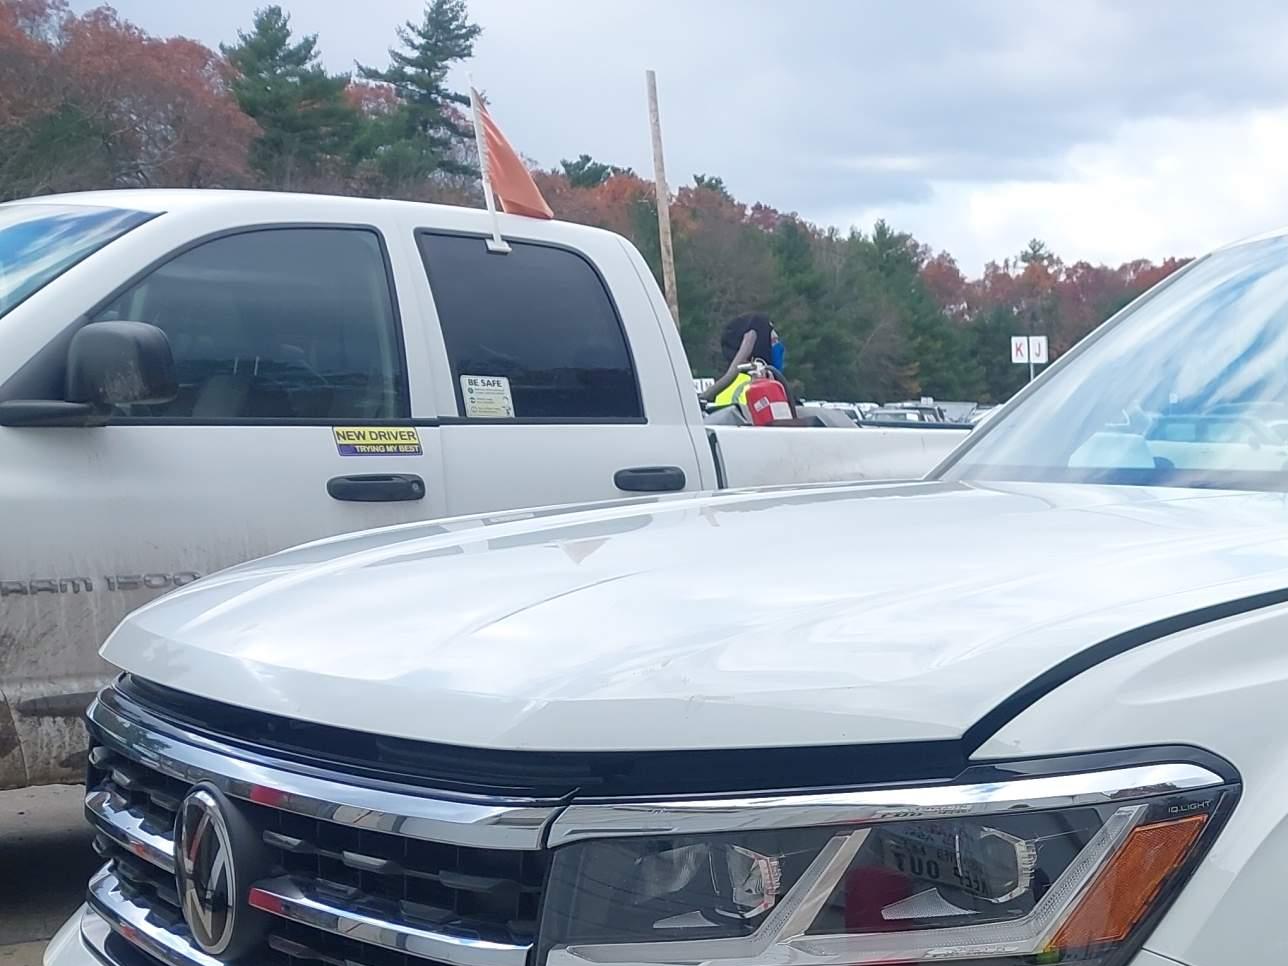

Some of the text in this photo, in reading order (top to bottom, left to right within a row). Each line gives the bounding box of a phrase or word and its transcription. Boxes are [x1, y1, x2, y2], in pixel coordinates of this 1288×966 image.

[1015, 342, 1024, 357] K
[1035, 342, 1041, 357] J
[467, 378, 503, 388] BE SAFE
[335, 430, 417, 441] NEW DRIVER
[356, 444, 419, 453] TRYING MY BEST
[104, 572, 200, 592] 1500
